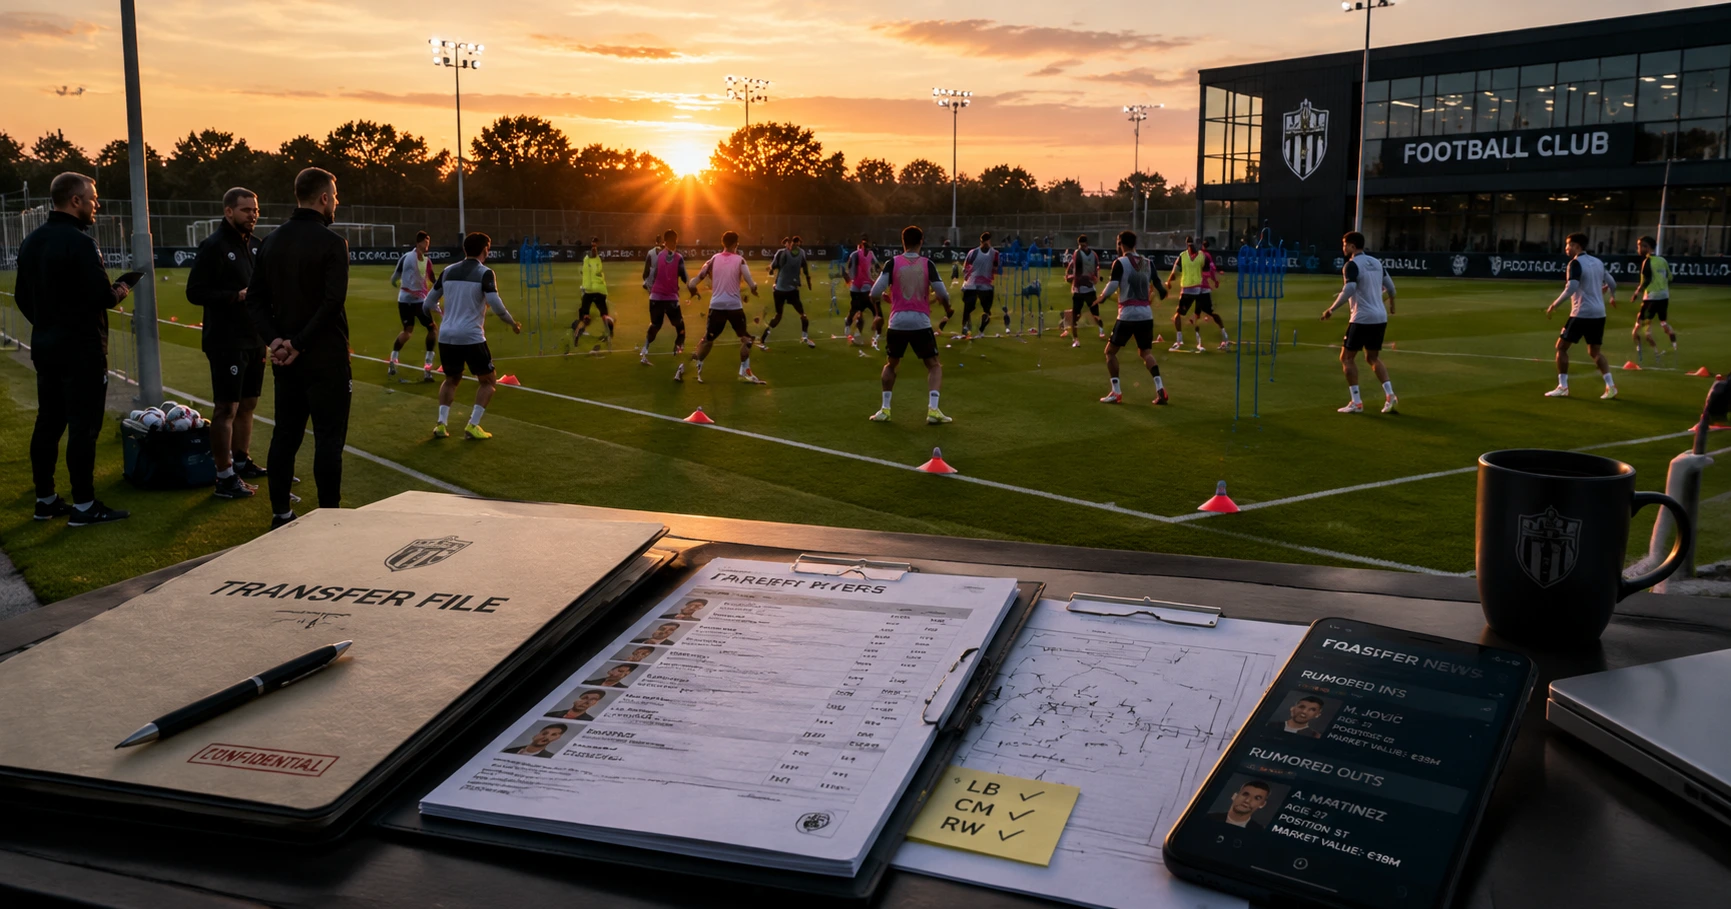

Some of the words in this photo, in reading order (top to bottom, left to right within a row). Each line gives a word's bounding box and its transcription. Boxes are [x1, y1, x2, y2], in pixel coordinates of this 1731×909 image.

[1403, 136, 1528, 164] FOOTBALL
[1537, 131, 1609, 157] CLUB
[209, 580, 416, 607] TRANSFER
[415, 592, 510, 614] FILE
[1423, 658, 1485, 679] NEWS
[1343, 704, 1358, 716] M.
[199, 747, 324, 773] CONFIDENTIAL
[1248, 746, 1334, 775] RUMORED
[1336, 766, 1385, 787] OUTS
[966, 779, 1001, 796] LB
[1291, 790, 1306, 801] A.
[954, 798, 995, 817] CM
[940, 816, 985, 836] RW
[1271, 824, 1320, 844] MARKET
[1278, 813, 1331, 835] POSITION
[1333, 828, 1350, 839] ST
